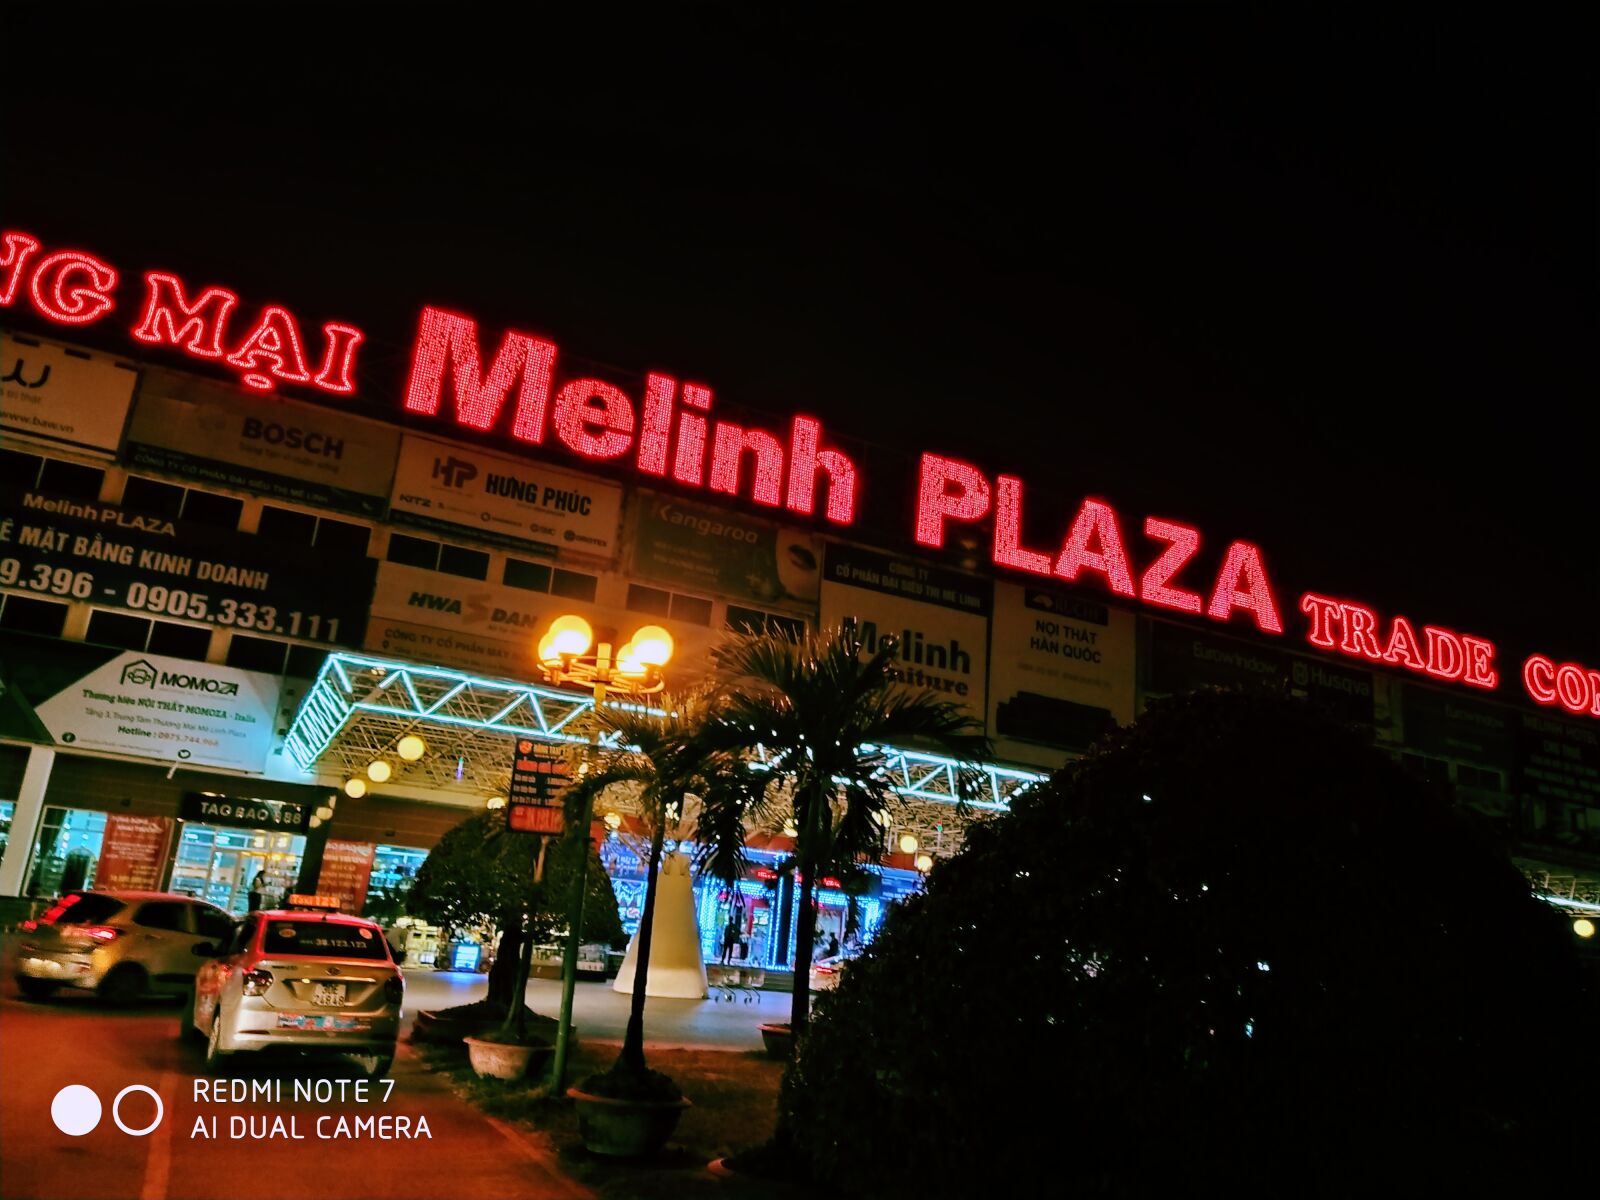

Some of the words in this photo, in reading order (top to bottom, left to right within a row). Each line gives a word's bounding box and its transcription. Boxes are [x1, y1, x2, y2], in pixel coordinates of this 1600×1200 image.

[131, 270, 364, 392] MẠI
[241, 416, 345, 460] BOSCH
[404, 306, 858, 524] Melinh
[915, 453, 1282, 632] PLAZA
[23, 493, 98, 521] Melinh
[100, 510, 177, 537] PLAZA
[485, 473, 538, 505] HƯNG
[542, 487, 592, 517] PHÚC
[660, 503, 759, 545] Kangaroo
[18, 526, 70, 554] MẶT
[73, 532, 135, 566] BẰNG
[139, 549, 195, 578] KINH
[196, 560, 270, 591] DOANH
[0, 558, 94, 598] 9.396
[126, 581, 341, 642] 0905.333.111
[1301, 593, 1498, 688] TRADE
[160, 671, 239, 696] MOMOZA
[117, 725, 151, 738] Hotline
[185, 705, 228, 720] MOMOZA
[200, 801, 232, 816] TAO
